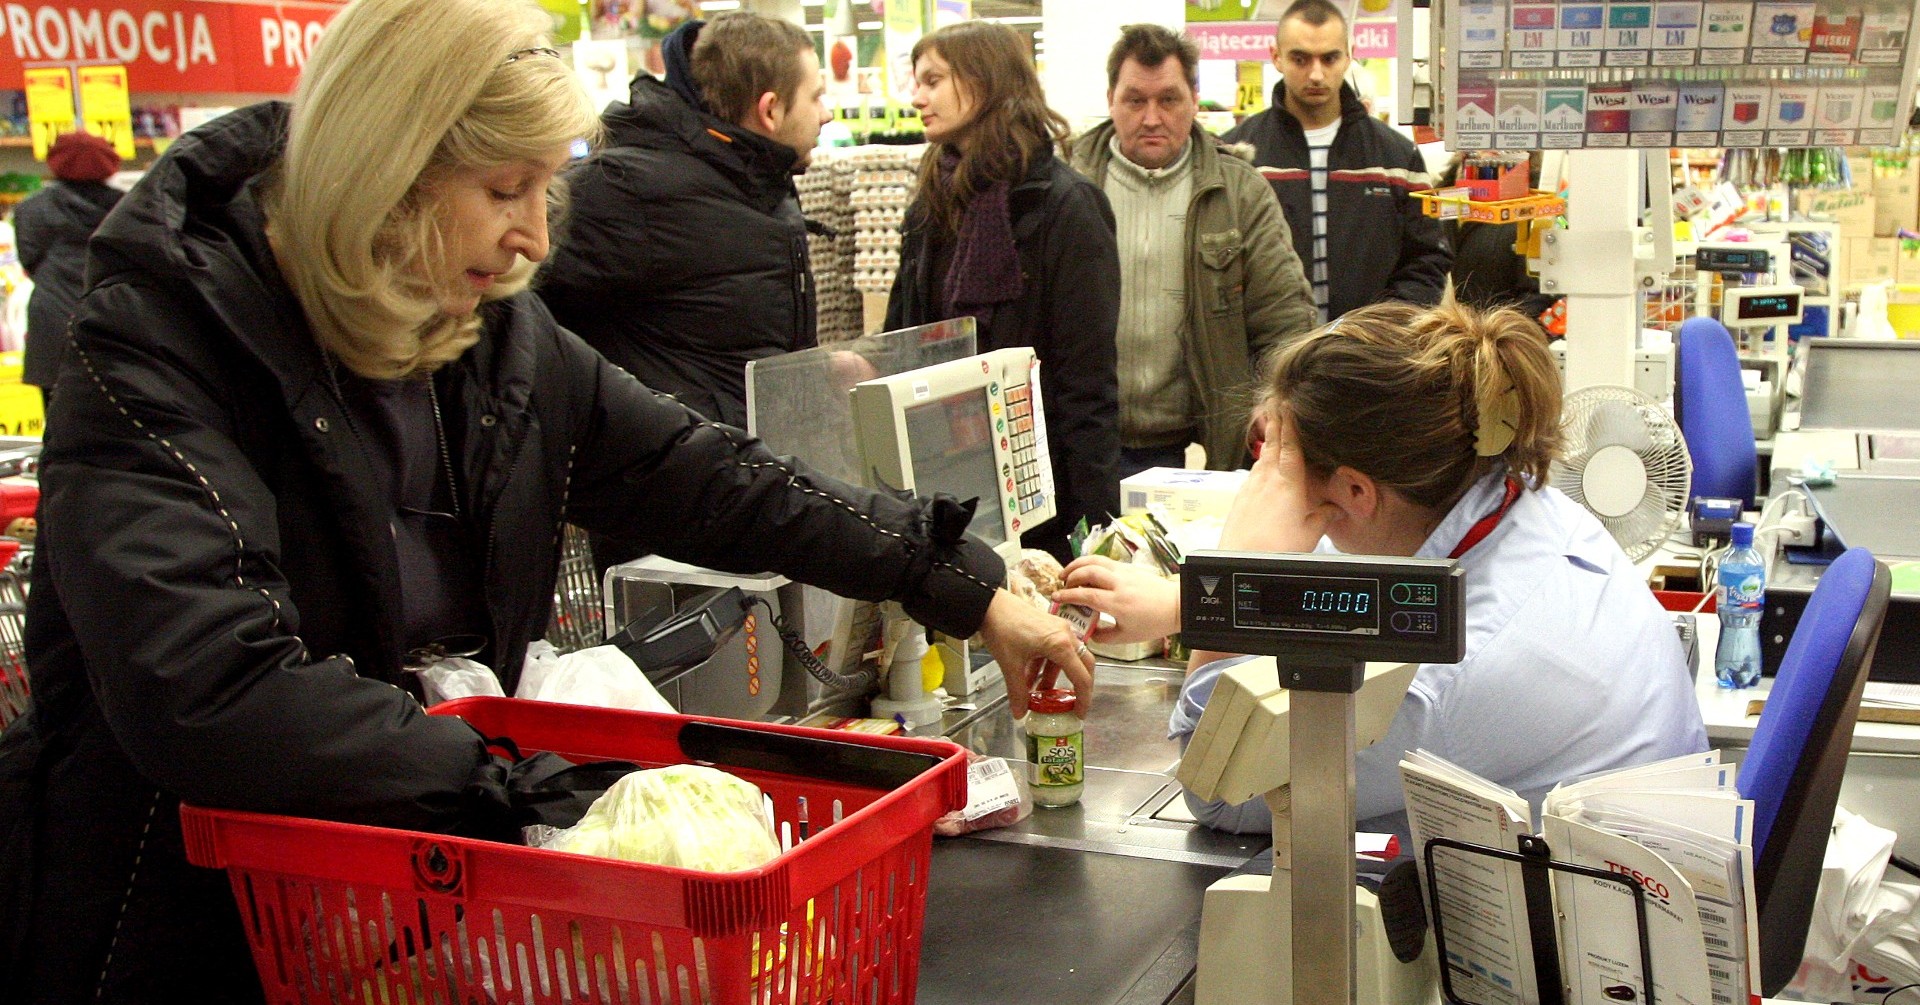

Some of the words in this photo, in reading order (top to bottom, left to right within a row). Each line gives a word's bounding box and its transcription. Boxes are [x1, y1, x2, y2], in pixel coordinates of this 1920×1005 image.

[1197, 30, 1277, 54] iąteczn
[1354, 28, 1389, 48] dki
[1594, 94, 1628, 107] West
[1637, 93, 1670, 106] West
[1684, 94, 1716, 106] West
[1500, 117, 1537, 131] Marlboro
[1545, 117, 1583, 131] Marlboro
[1201, 596, 1220, 604] DIGI
[1302, 590, 1370, 613] 0.000
[1049, 746, 1075, 757] SOS
[1604, 860, 1670, 899] TESCO
